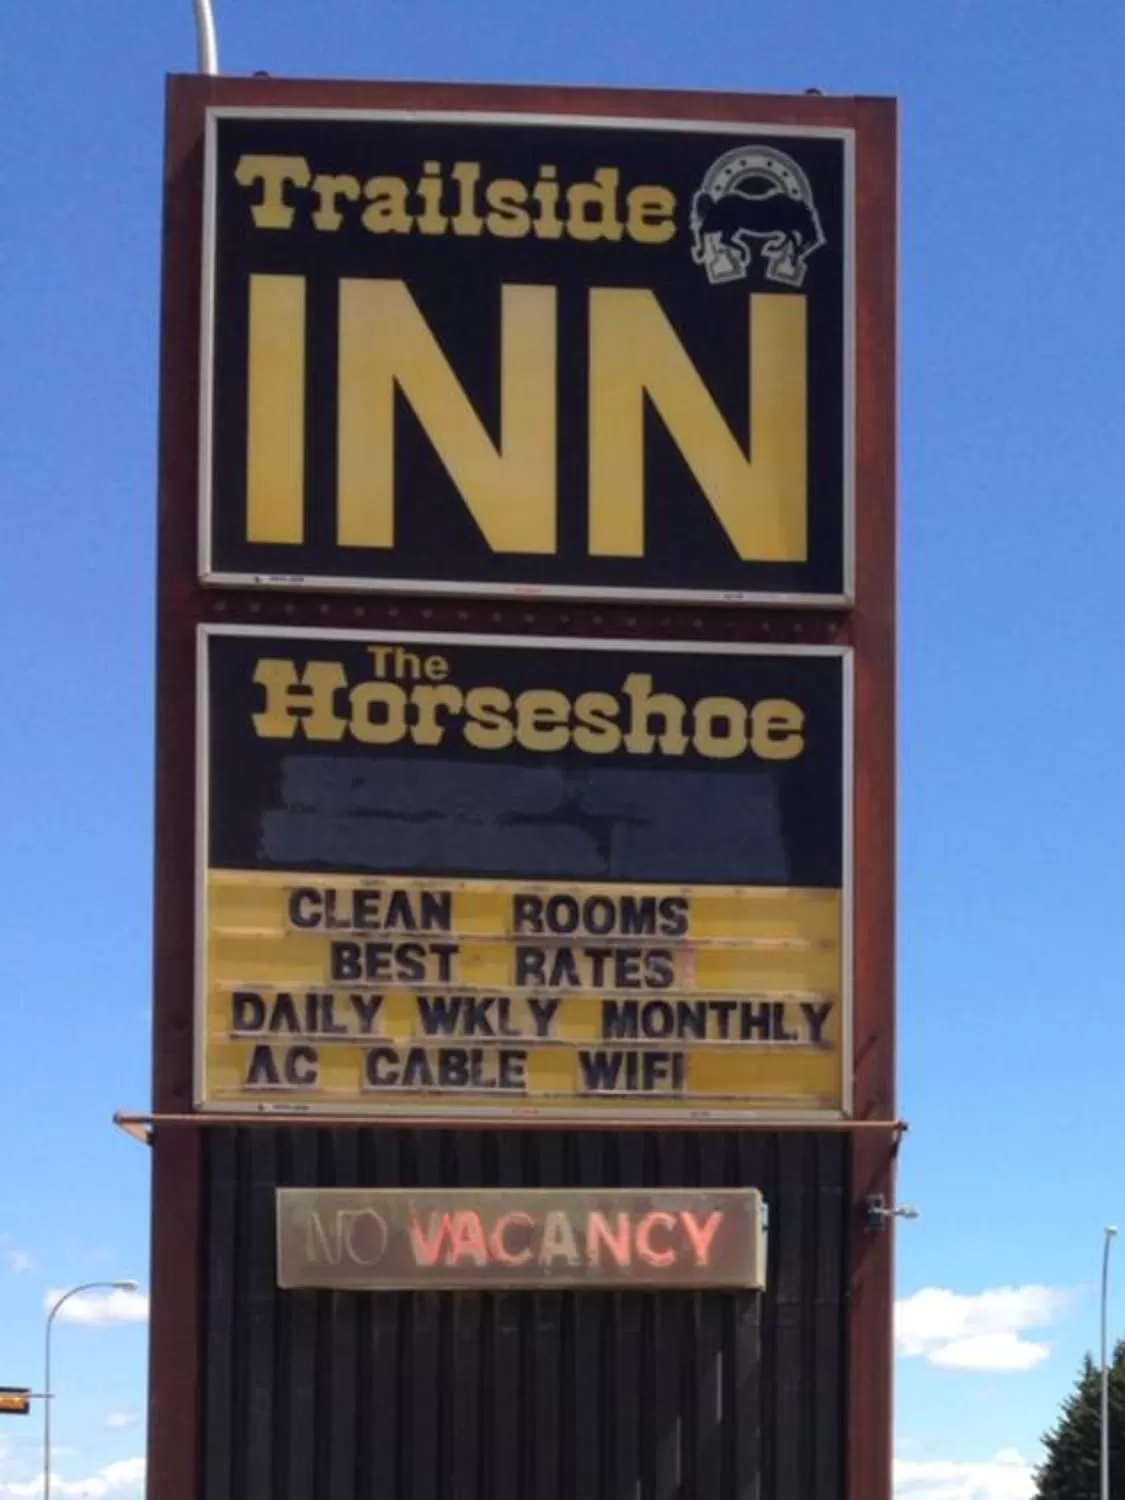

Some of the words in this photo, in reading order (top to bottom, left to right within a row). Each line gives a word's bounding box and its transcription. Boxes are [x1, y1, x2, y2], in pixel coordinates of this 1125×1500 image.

[234, 154, 677, 244] Trailside
[246, 273, 807, 562] INN
[367, 645, 448, 680] The
[252, 658, 806, 760] Horseshoe
[288, 887, 452, 931] CLEAN
[513, 893, 689, 936] ROOMS
[331, 941, 458, 982] BEST
[516, 947, 674, 988] RATES
[232, 991, 384, 1034] DAILY
[416, 995, 560, 1037] WKLY
[602, 1000, 833, 1043] MONTHLY
[246, 1045, 318, 1086] AC
[366, 1046, 528, 1089] CABLE
[579, 1051, 685, 1091] WIFI
[306, 1208, 388, 1266] NO
[408, 1208, 724, 1267] VACANCY
